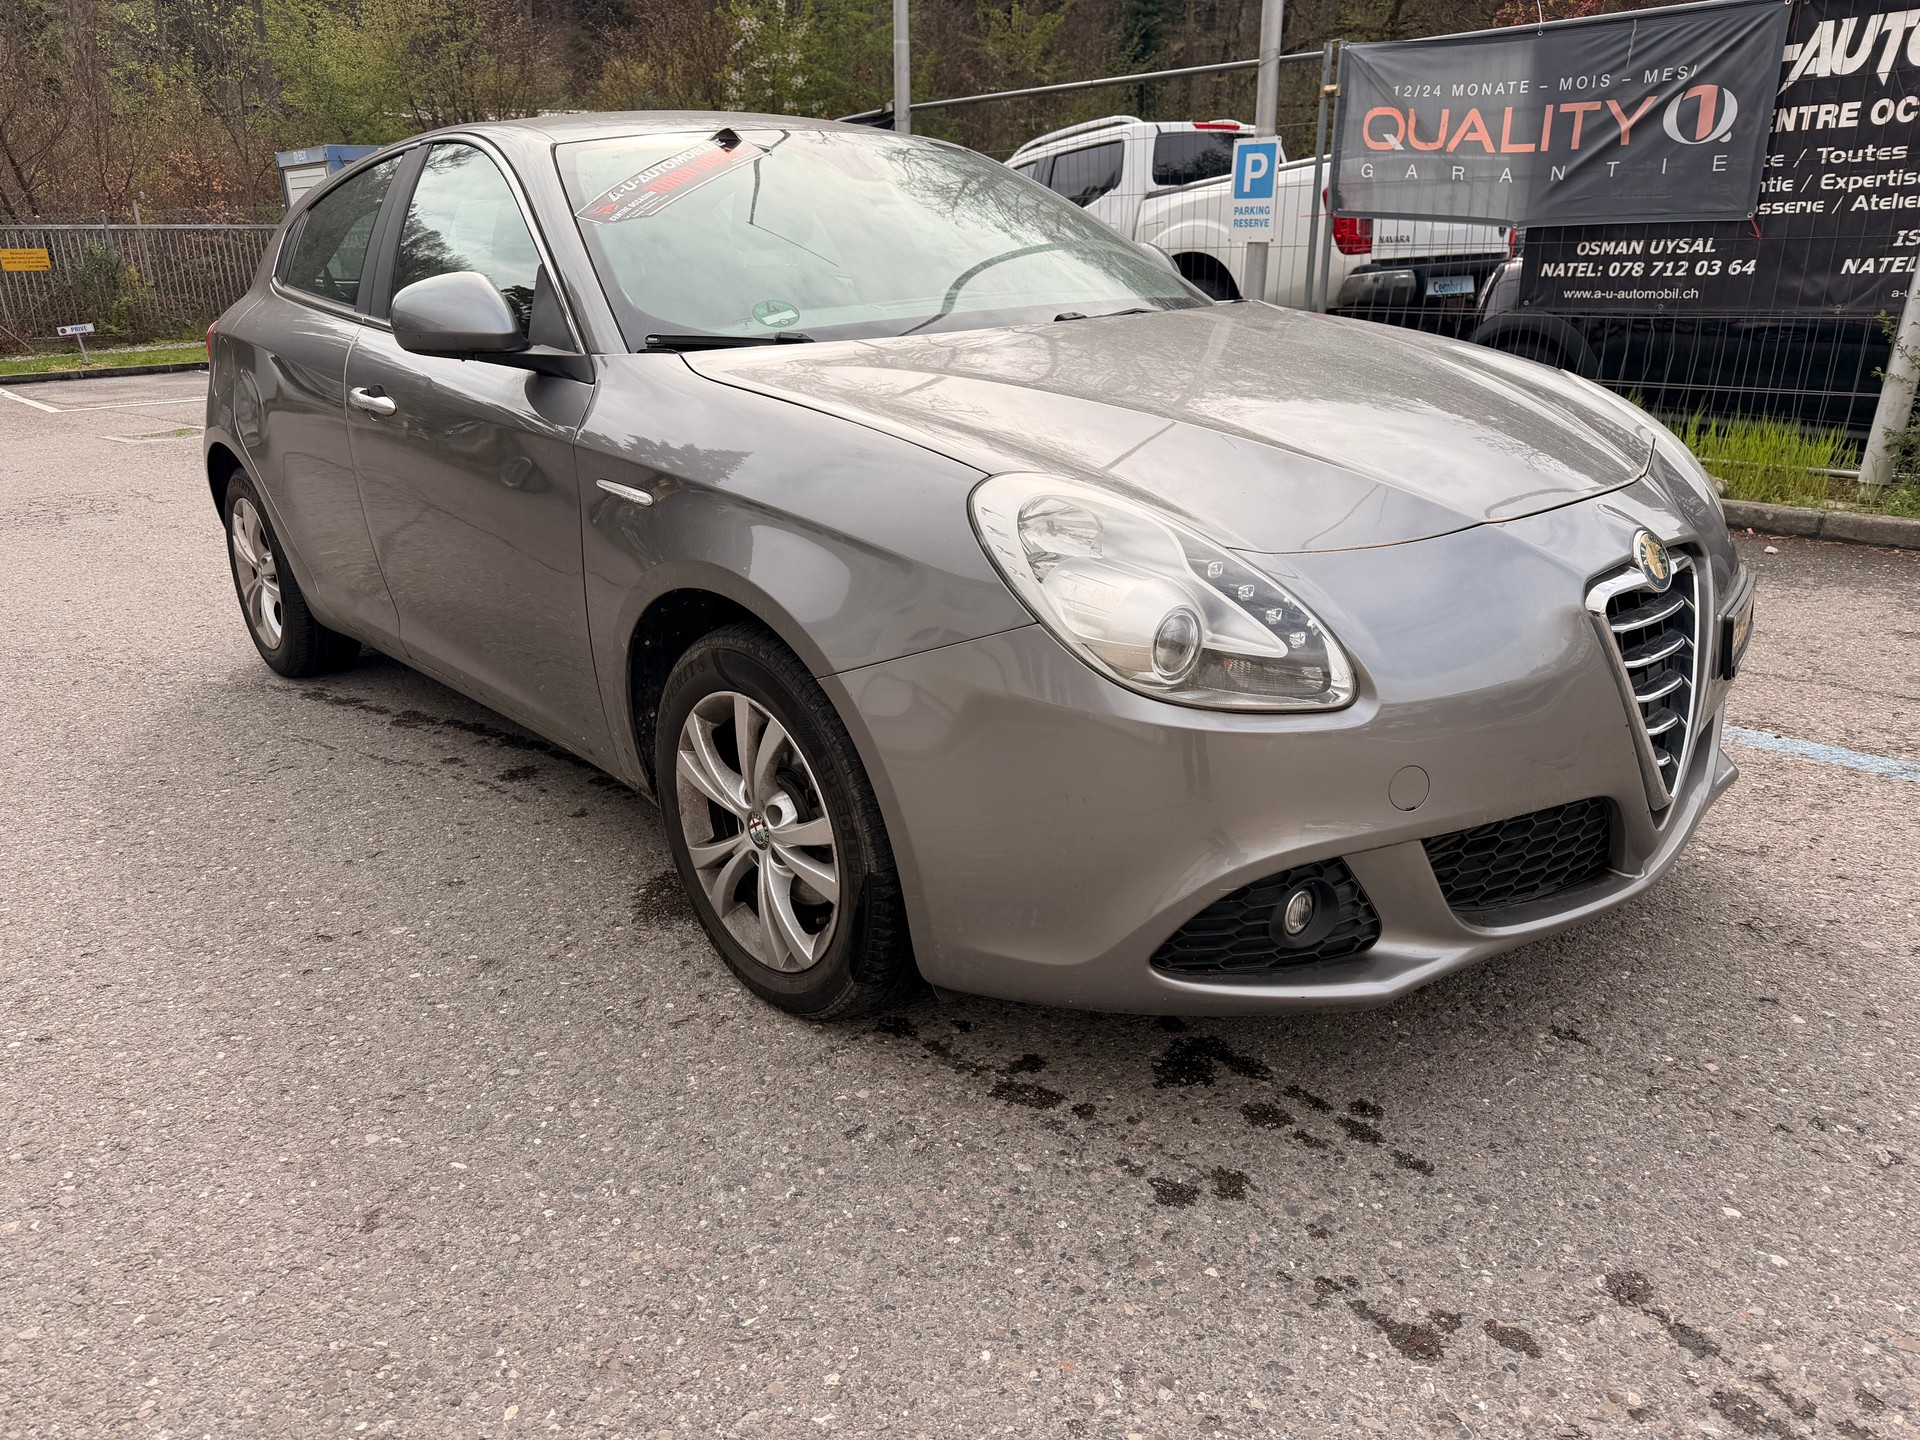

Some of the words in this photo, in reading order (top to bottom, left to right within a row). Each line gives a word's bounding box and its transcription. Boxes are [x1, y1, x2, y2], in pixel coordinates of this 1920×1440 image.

[1393, 84, 1441, 98] 12/24
[1451, 80, 1530, 97] MONATE
[1558, 74, 1612, 92] MOIS
[1643, 64, 1698, 84] MESI
[1362, 95, 1659, 152] QUALITY
[1816, 144, 1909, 165] Toutes
[1243, 152, 1269, 193] P
[1360, 154, 1728, 184] GARANTIE
[1820, 168, 1920, 193] Expertis
[1233, 205, 1271, 216] PARKING
[1755, 200, 1825, 216] sserie
[1233, 218, 1270, 228] RESERVE
[1379, 234, 1411, 244] NAVARA
[1576, 239, 1645, 256] OSMAN
[1649, 237, 1717, 255] UYSAL
[1539, 262, 1603, 278] NATEL:
[1607, 262, 1645, 277] 078
[1649, 261, 1690, 277] 712
[1694, 260, 1723, 276] 03
[1728, 259, 1758, 275] 64
[1433, 280, 1467, 294] Cembr
[1563, 287, 1700, 300] www.a-u-automobil.ch
